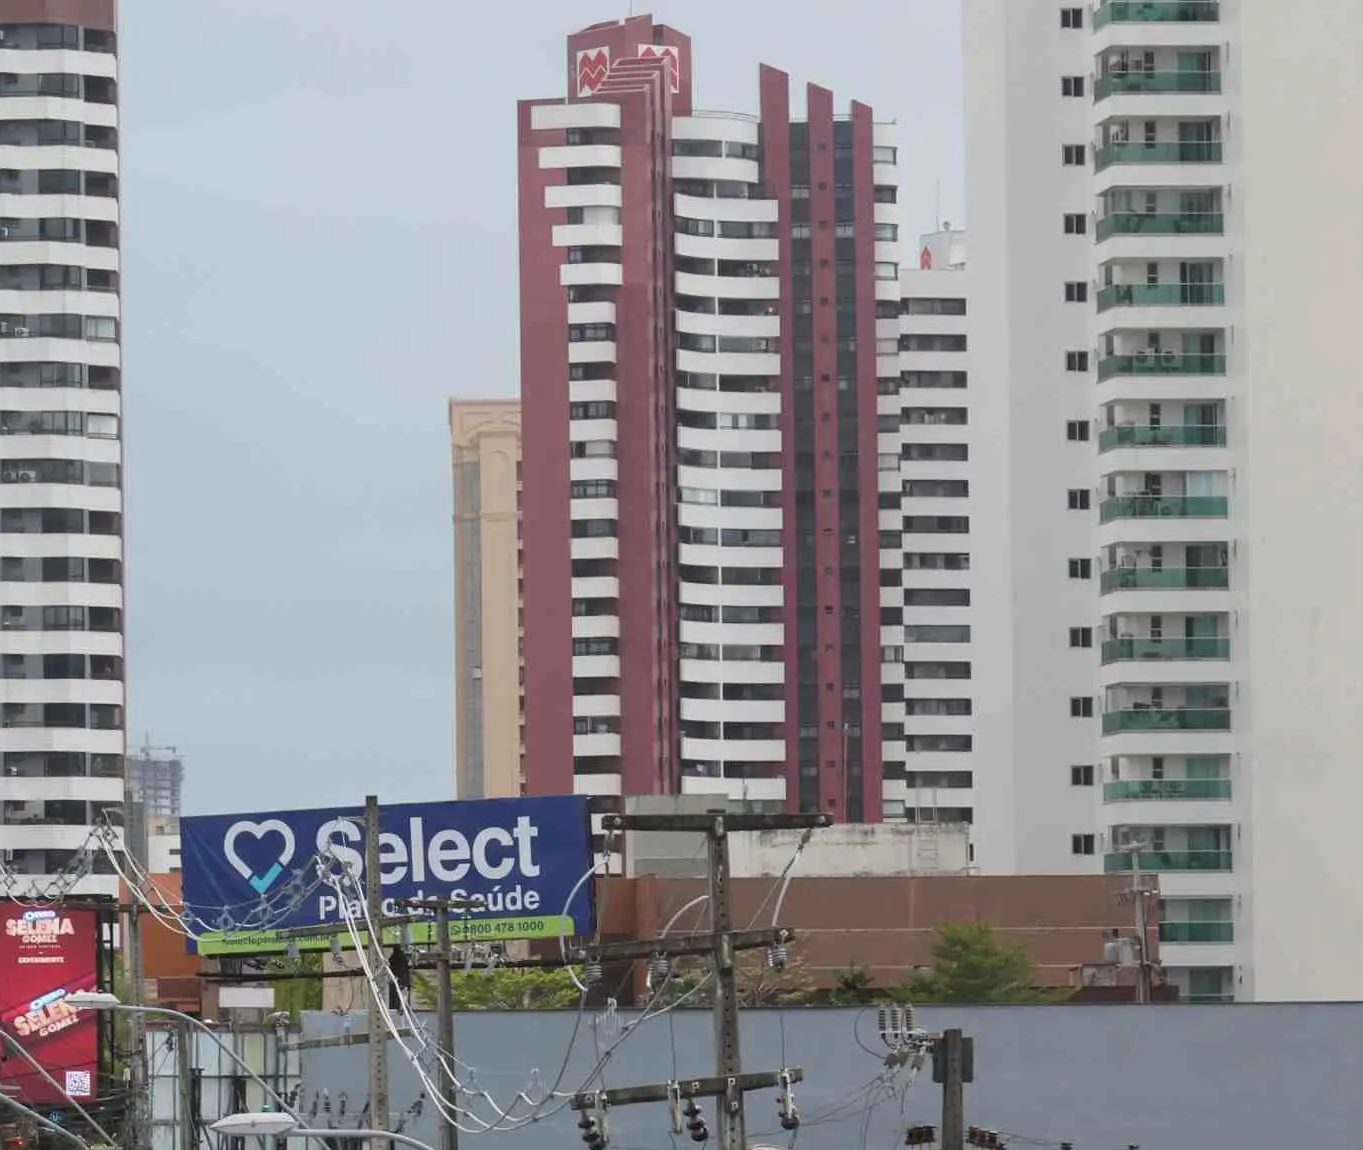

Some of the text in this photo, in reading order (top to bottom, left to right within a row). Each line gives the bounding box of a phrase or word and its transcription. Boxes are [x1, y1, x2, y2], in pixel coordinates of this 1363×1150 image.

[315, 814, 540, 888] Select
[319, 892, 396, 921] Plao
[450, 884, 540, 913] Saúde
[5, 917, 76, 936] SELENA
[494, 923, 515, 932] 478
[517, 921, 545, 931] 1000
